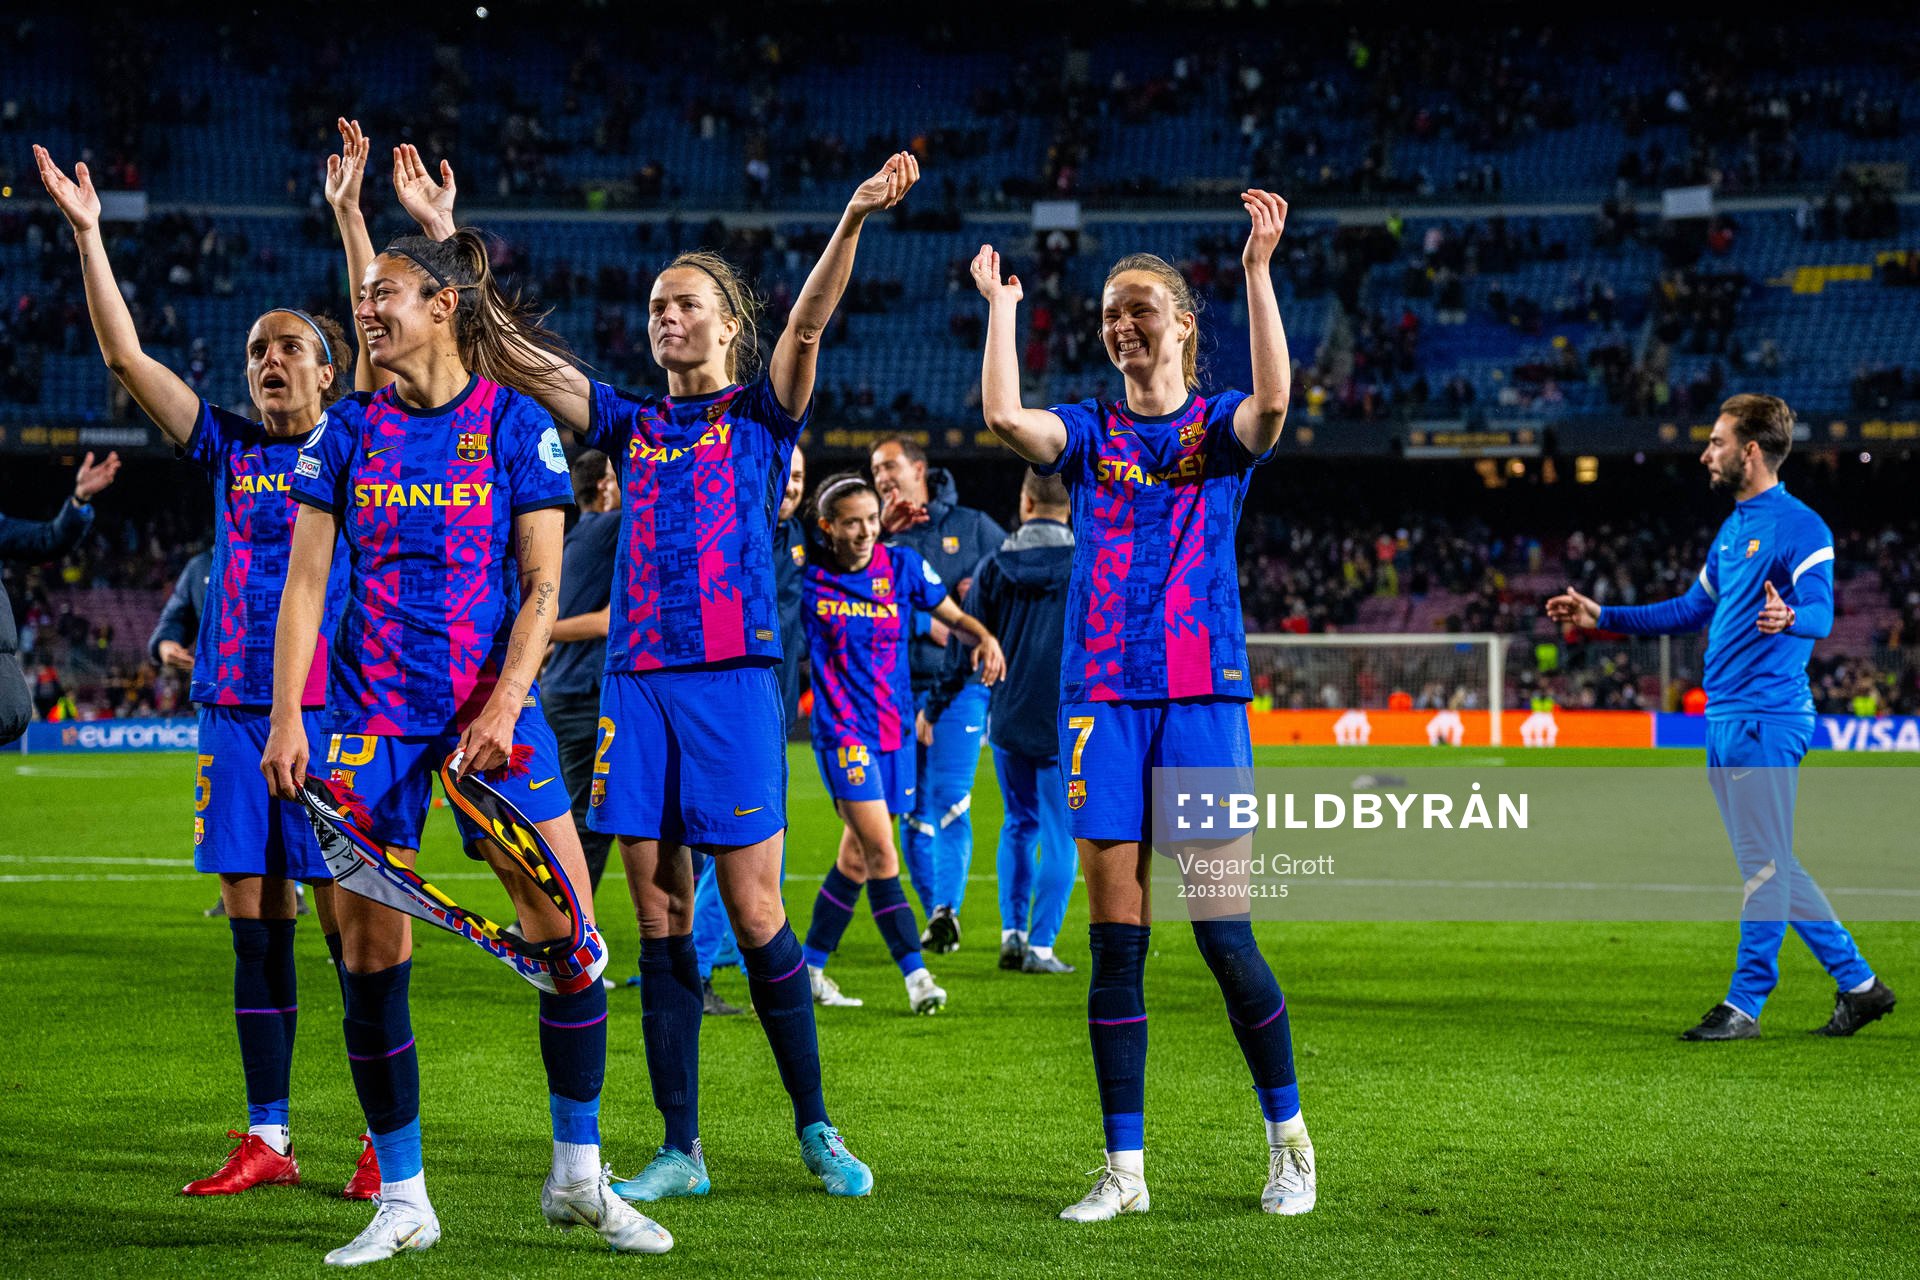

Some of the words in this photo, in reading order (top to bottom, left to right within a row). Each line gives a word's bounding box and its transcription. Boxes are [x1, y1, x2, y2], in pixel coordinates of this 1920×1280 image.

[354, 483, 493, 507] STANLEY
[816, 599, 898, 618] STANLEY
[593, 716, 616, 774] 2
[1068, 716, 1095, 775] 7
[1822, 717, 1920, 752] VISA
[837, 744, 870, 768] 14
